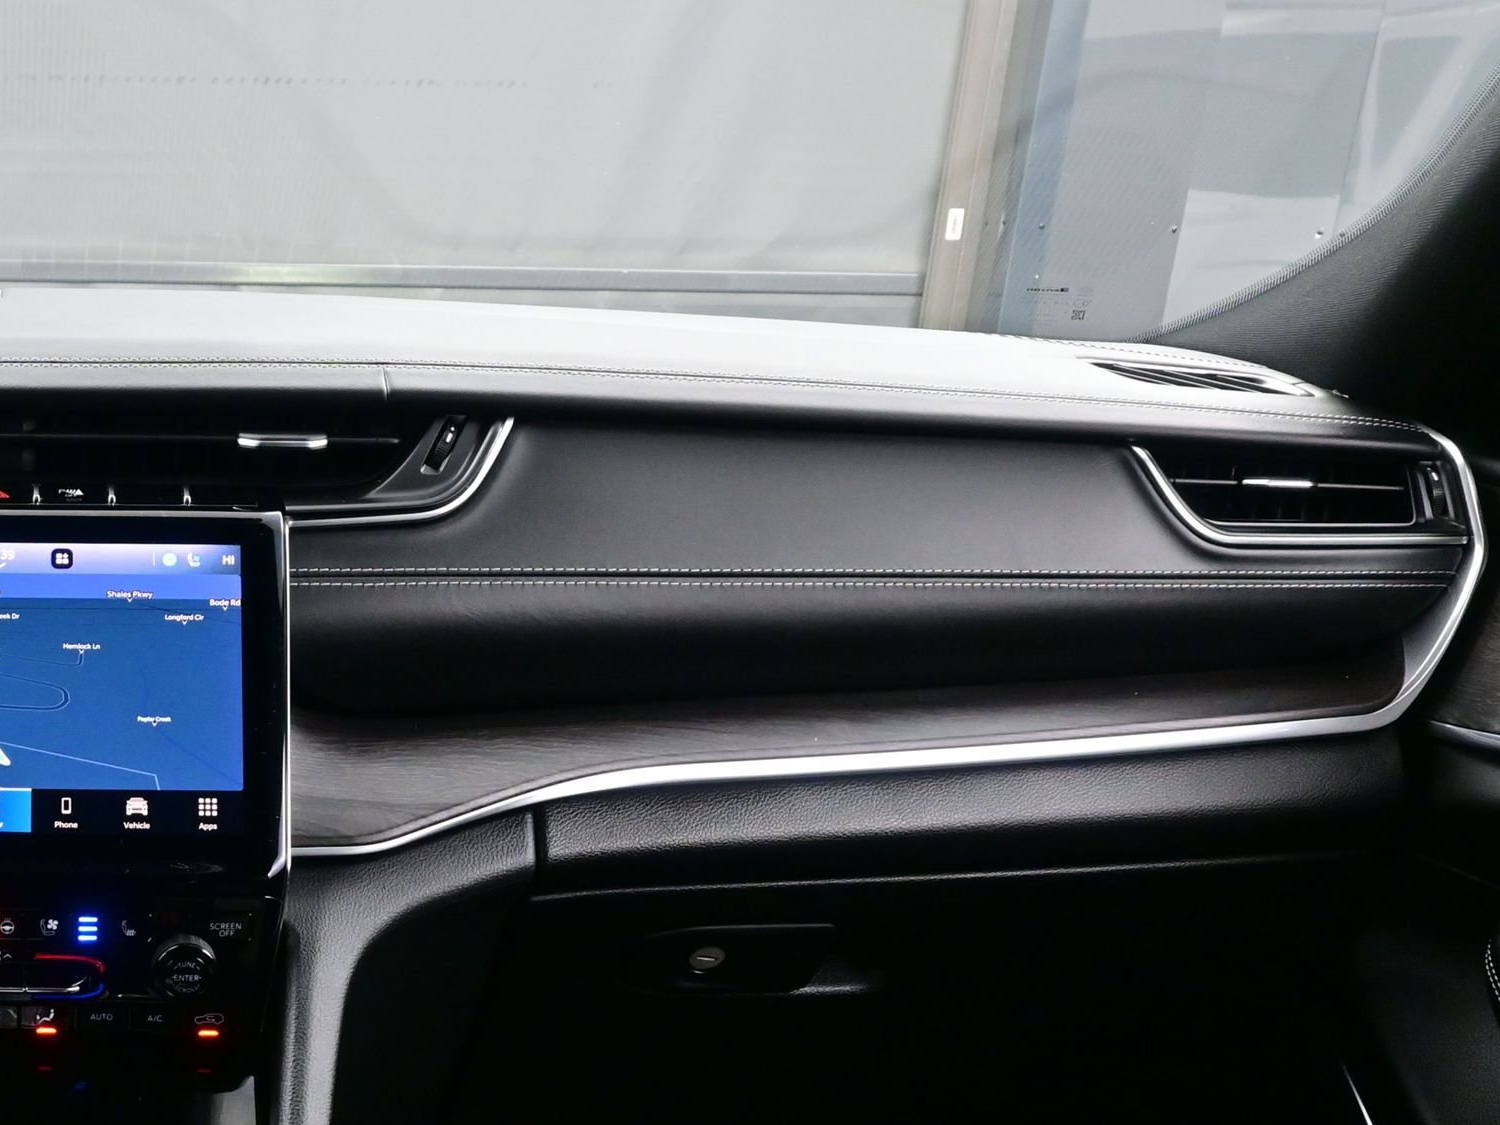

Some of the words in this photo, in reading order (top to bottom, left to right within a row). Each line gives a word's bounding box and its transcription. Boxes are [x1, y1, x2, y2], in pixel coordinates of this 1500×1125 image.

[222, 554, 235, 565] HI
[107, 590, 131, 598] Shales
[133, 590, 154, 600] Pkwy
[209, 599, 229, 607] Bode
[230, 599, 242, 607] Rd
[164, 613, 194, 622] Longford
[195, 613, 205, 621] Cir
[62, 642, 91, 650] Hemlock
[54, 820, 78, 829] Phone
[123, 821, 151, 830] Vehicle
[198, 822, 218, 831] Apps
[209, 922, 242, 931] SCREEN
[218, 930, 235, 938] OFF
[177, 960, 197, 970] TUNE
[173, 974, 200, 983] ENTER
[90, 1013, 114, 1021] AUTO
[147, 1014, 163, 1023] A/C
